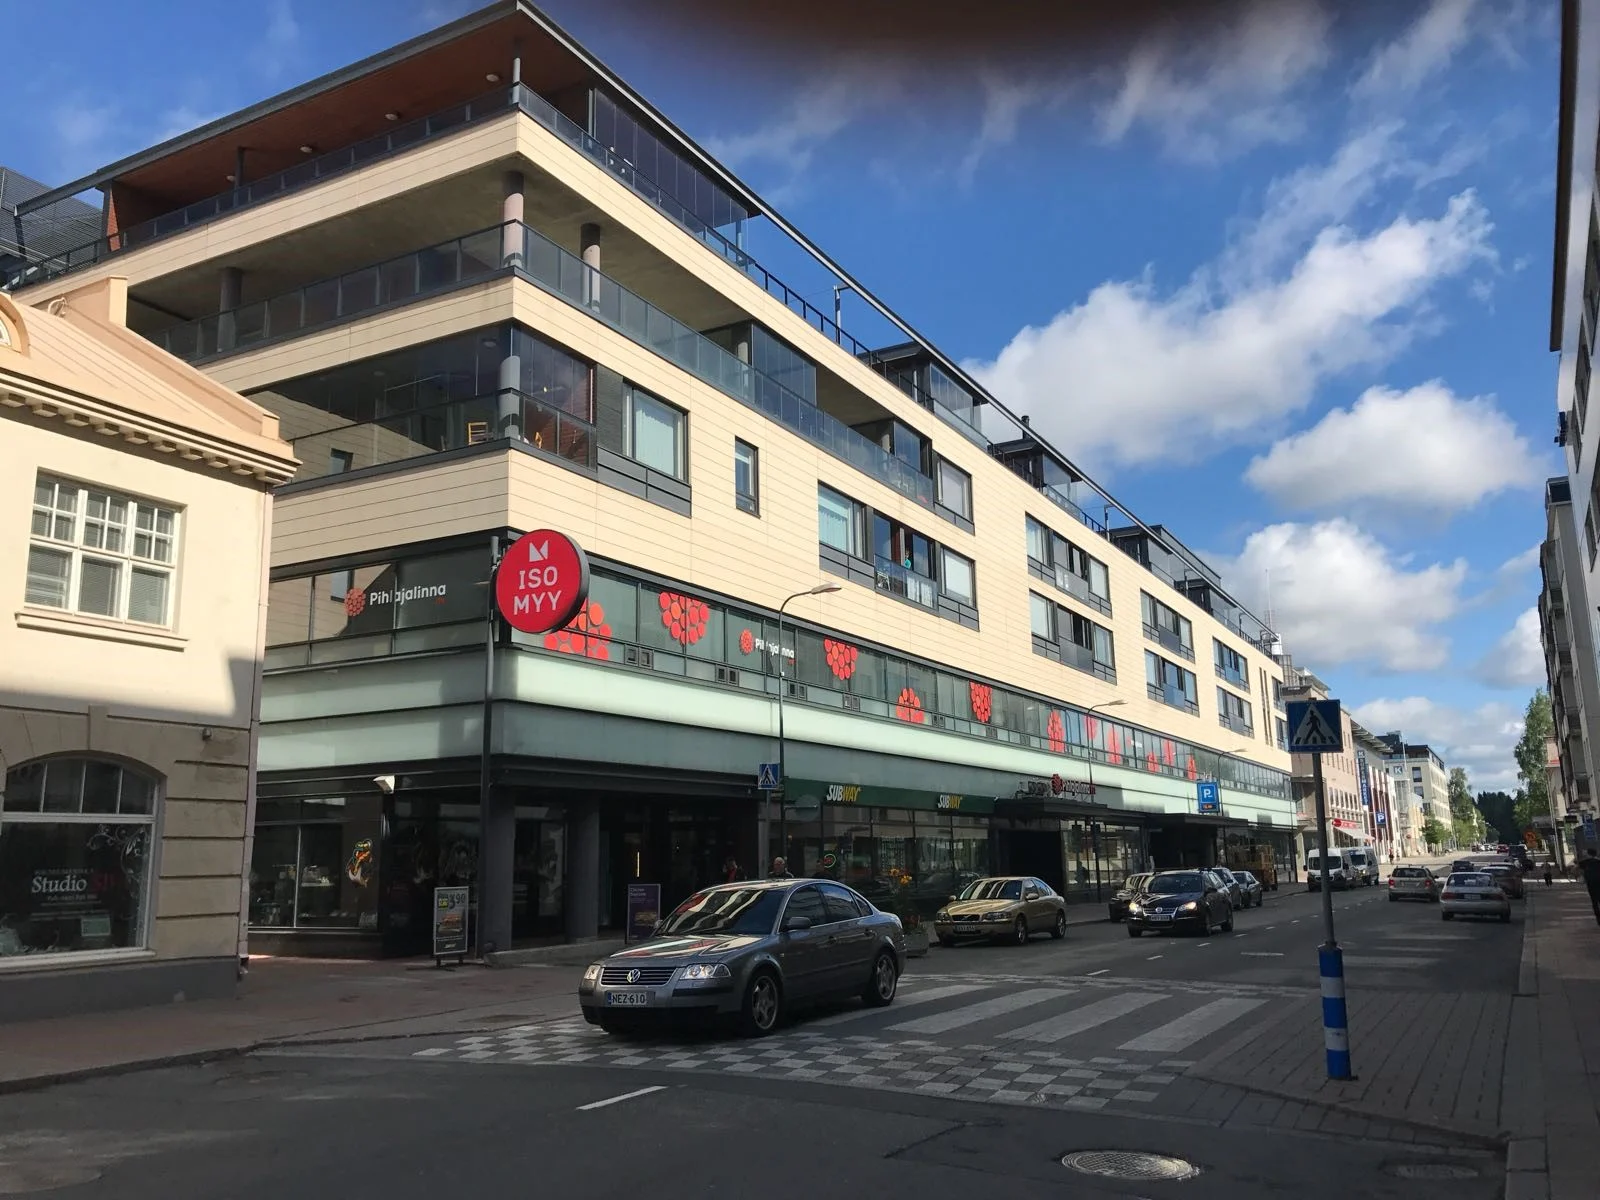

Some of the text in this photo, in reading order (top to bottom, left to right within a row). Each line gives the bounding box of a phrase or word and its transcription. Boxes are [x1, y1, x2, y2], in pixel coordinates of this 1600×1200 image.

[518, 565, 559, 591] ISO
[369, 584, 446, 606] Pihlajalinna
[512, 590, 562, 616] MYY
[826, 784, 860, 802] SUBWAY
[937, 794, 961, 809] SUBWAY
[31, 874, 87, 893] Studio
[612, 994, 646, 1004] NEZ-610
